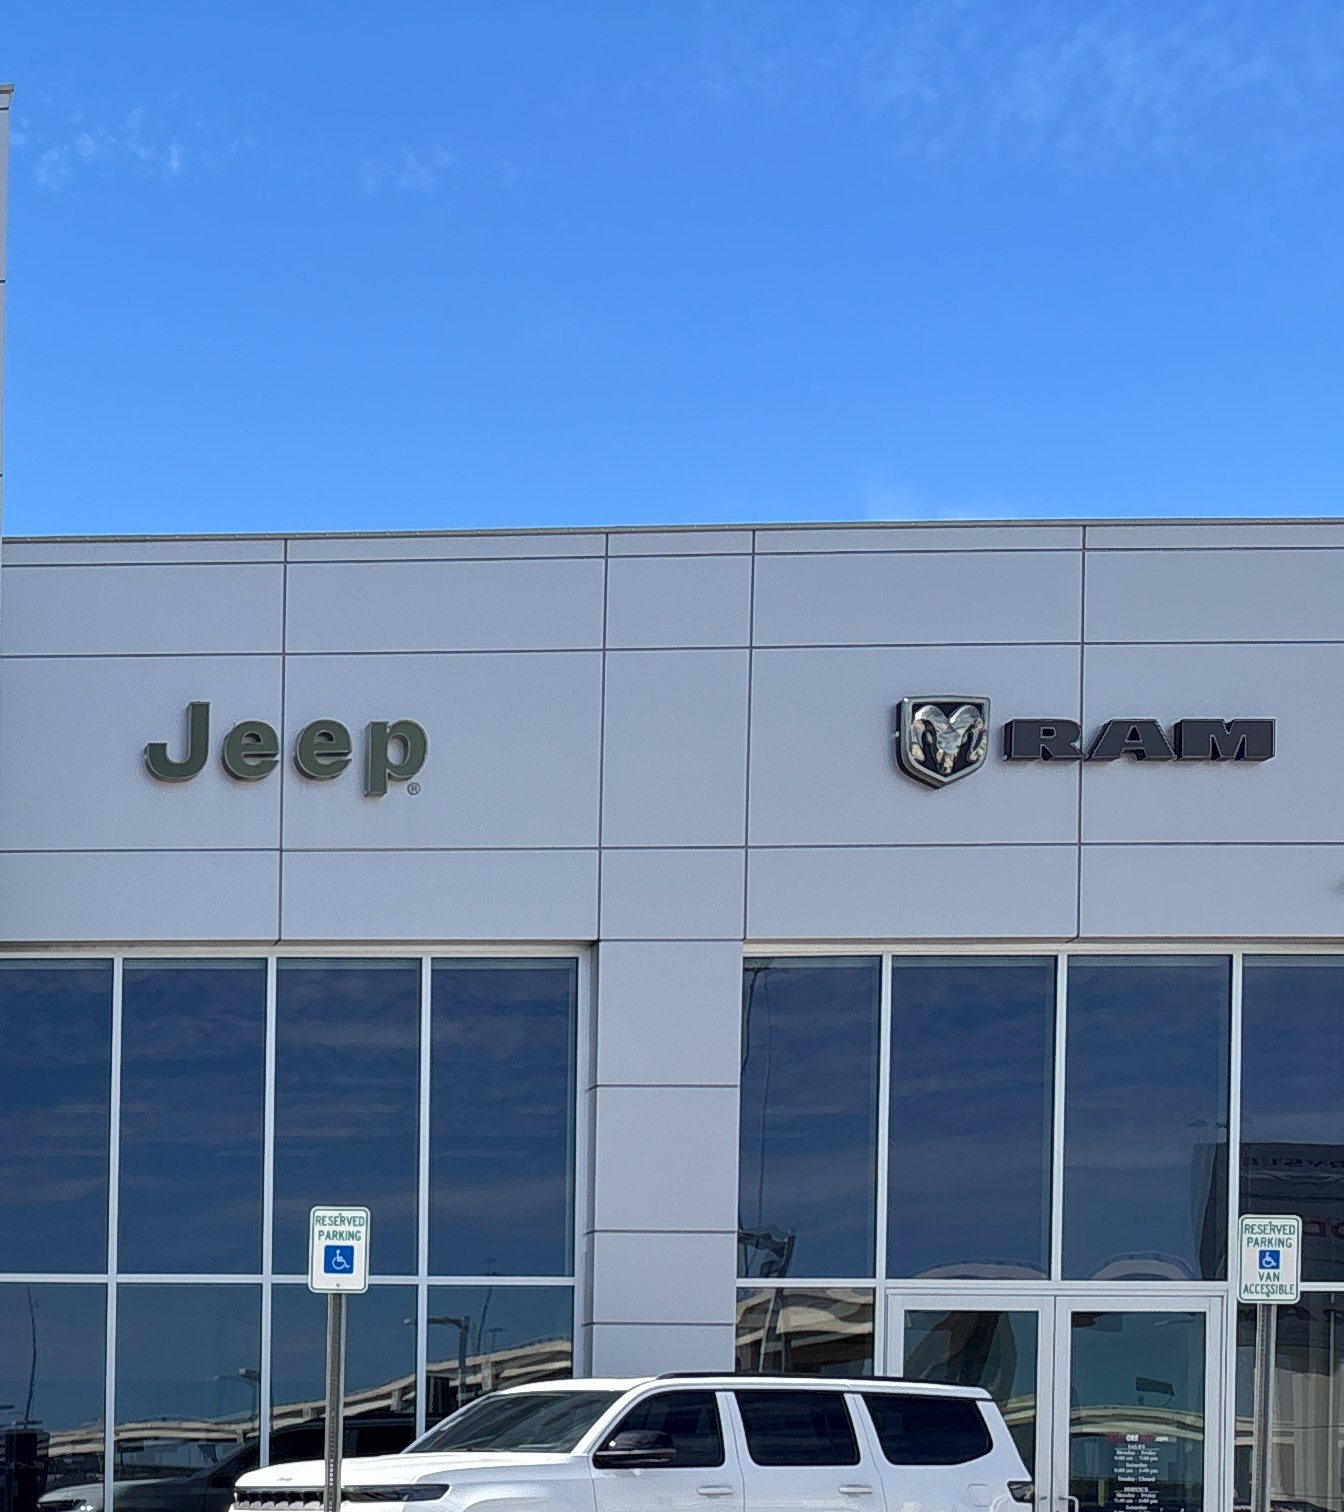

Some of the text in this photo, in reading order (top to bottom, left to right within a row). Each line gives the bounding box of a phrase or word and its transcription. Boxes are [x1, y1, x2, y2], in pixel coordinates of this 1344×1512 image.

[1004, 718, 1276, 762] RAM
[144, 701, 428, 797] Jeep
[315, 1215, 365, 1227] RESERVED
[1244, 1223, 1296, 1235] RESERVED
[318, 1230, 362, 1241] PARKING
[1247, 1236, 1293, 1248] PARKING
[1258, 1271, 1281, 1282] VAN
[1243, 1283, 1295, 1295] ACCESSIBLE
